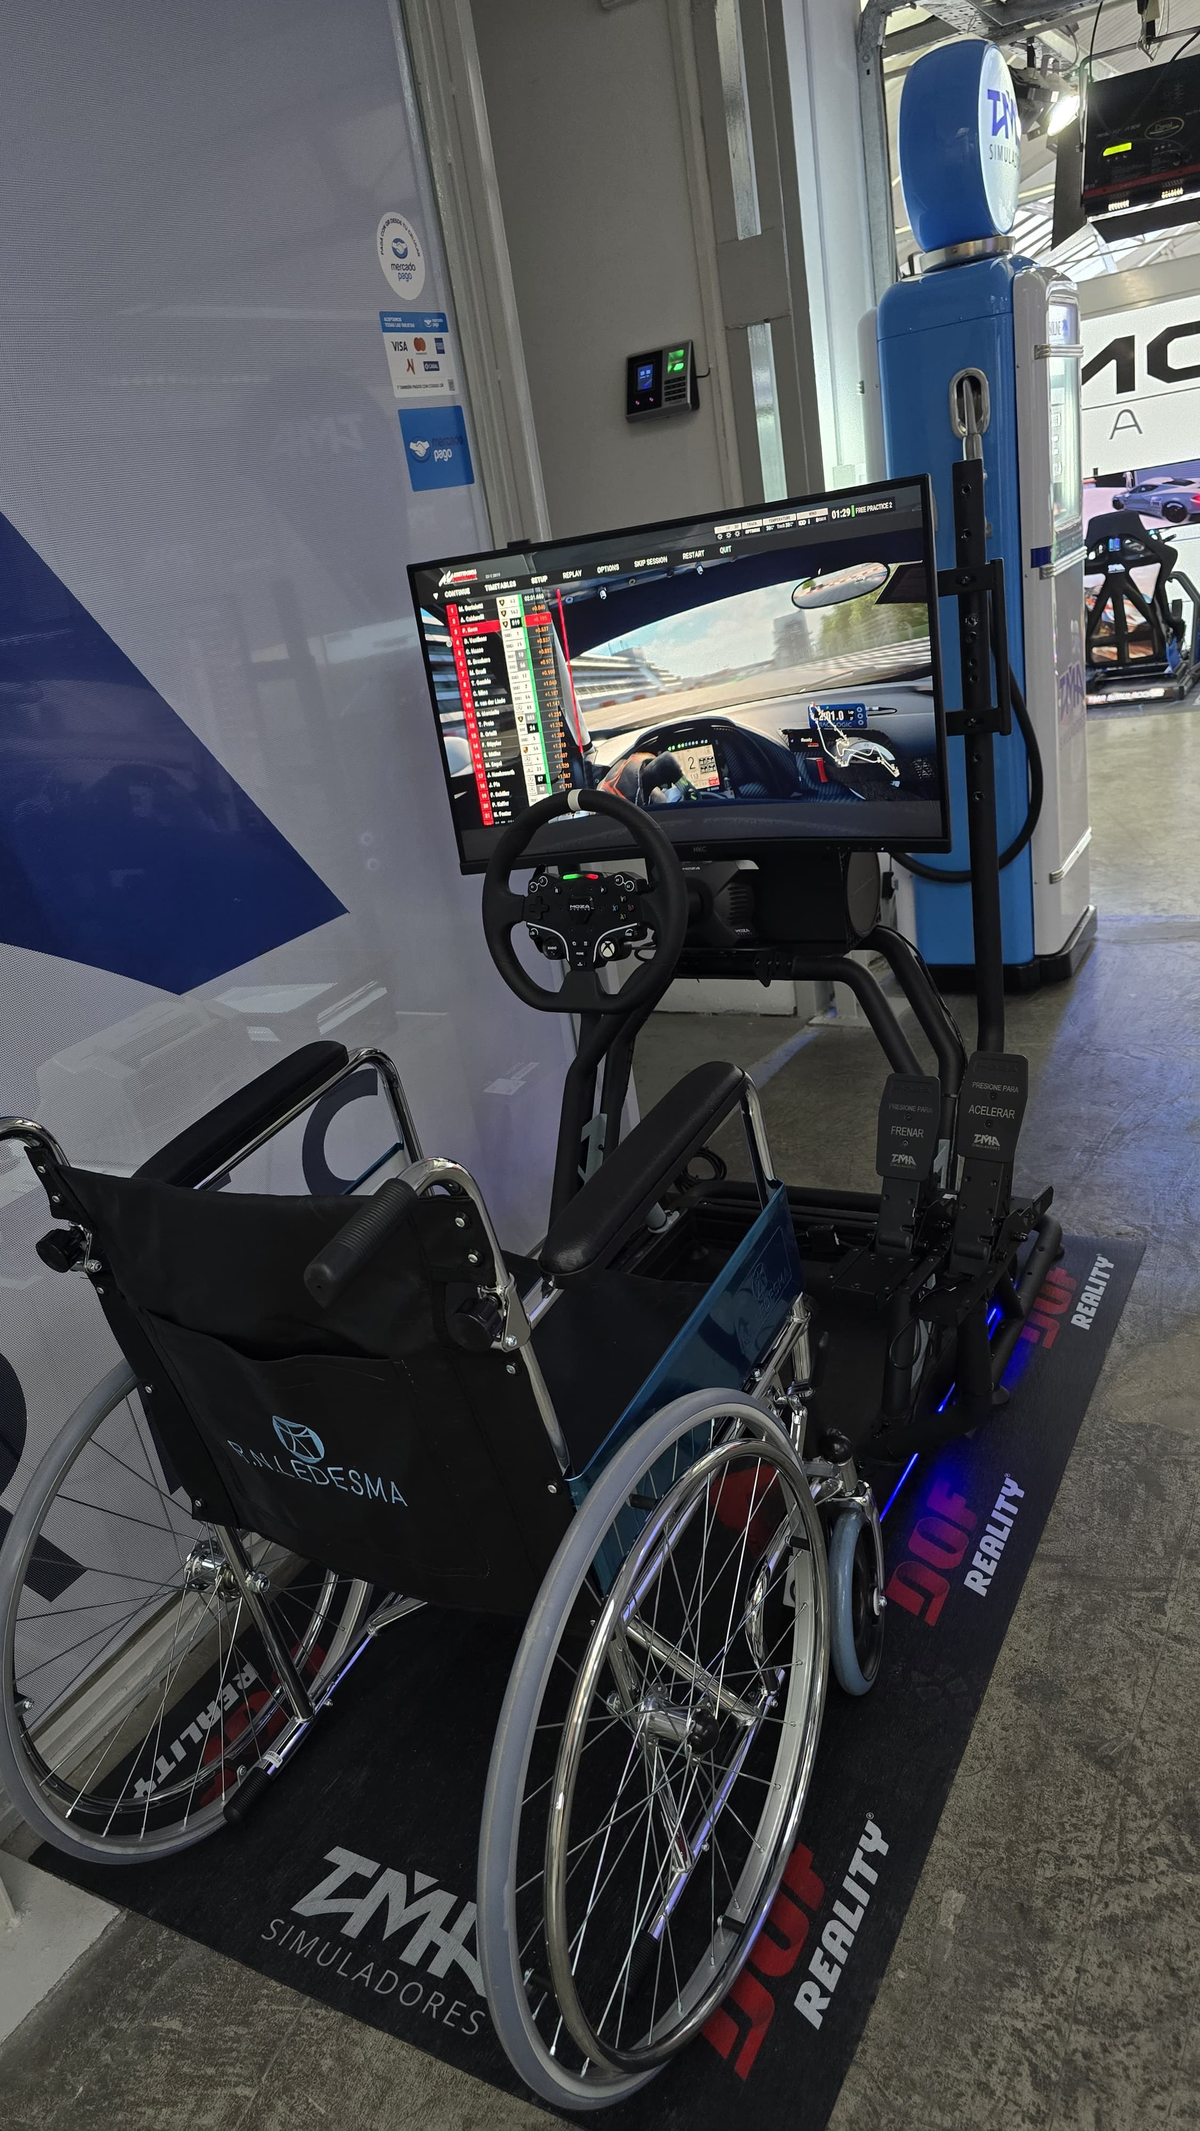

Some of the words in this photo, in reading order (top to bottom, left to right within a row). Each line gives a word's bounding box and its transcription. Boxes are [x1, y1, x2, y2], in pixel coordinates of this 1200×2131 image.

[390, 262, 416, 272] mercado
[398, 272, 412, 282] pago
[391, 341, 408, 352] VISA
[434, 448, 452, 462] pago
[867, 502, 889, 512] PRACTICE
[832, 508, 850, 520] 01:29
[444, 588, 471, 598] CONTINUE
[484, 580, 517, 592] TIMETABLES
[531, 575, 548, 584] SETUP
[562, 570, 583, 580] REPLAY
[596, 564, 620, 574] OPTIONS
[634, 559, 645, 568] SKIP
[646, 556, 668, 566] SESSION
[682, 550, 705, 560] RESTART
[719, 545, 732, 554] QUIT
[688, 757, 696, 770] 2
[972, 1081, 1002, 1091] PRESIONE
[1002, 1084, 1019, 1093] PARA
[889, 1103, 916, 1112] PRESIONE
[917, 1106, 933, 1114] PARA
[968, 1104, 1015, 1119] ACELERAR
[891, 1126, 924, 1138] FRENAR
[973, 1134, 1000, 1146] TMA
[891, 1154, 916, 1166] TMA
[1070, 1254, 1115, 1330] REALITY
[964, 1476, 1025, 1598] REALITY
[134, 1661, 260, 1798] REALITY
[794, 1820, 890, 2030] REALITY
[260, 1918, 486, 2035] SIMULADORES
